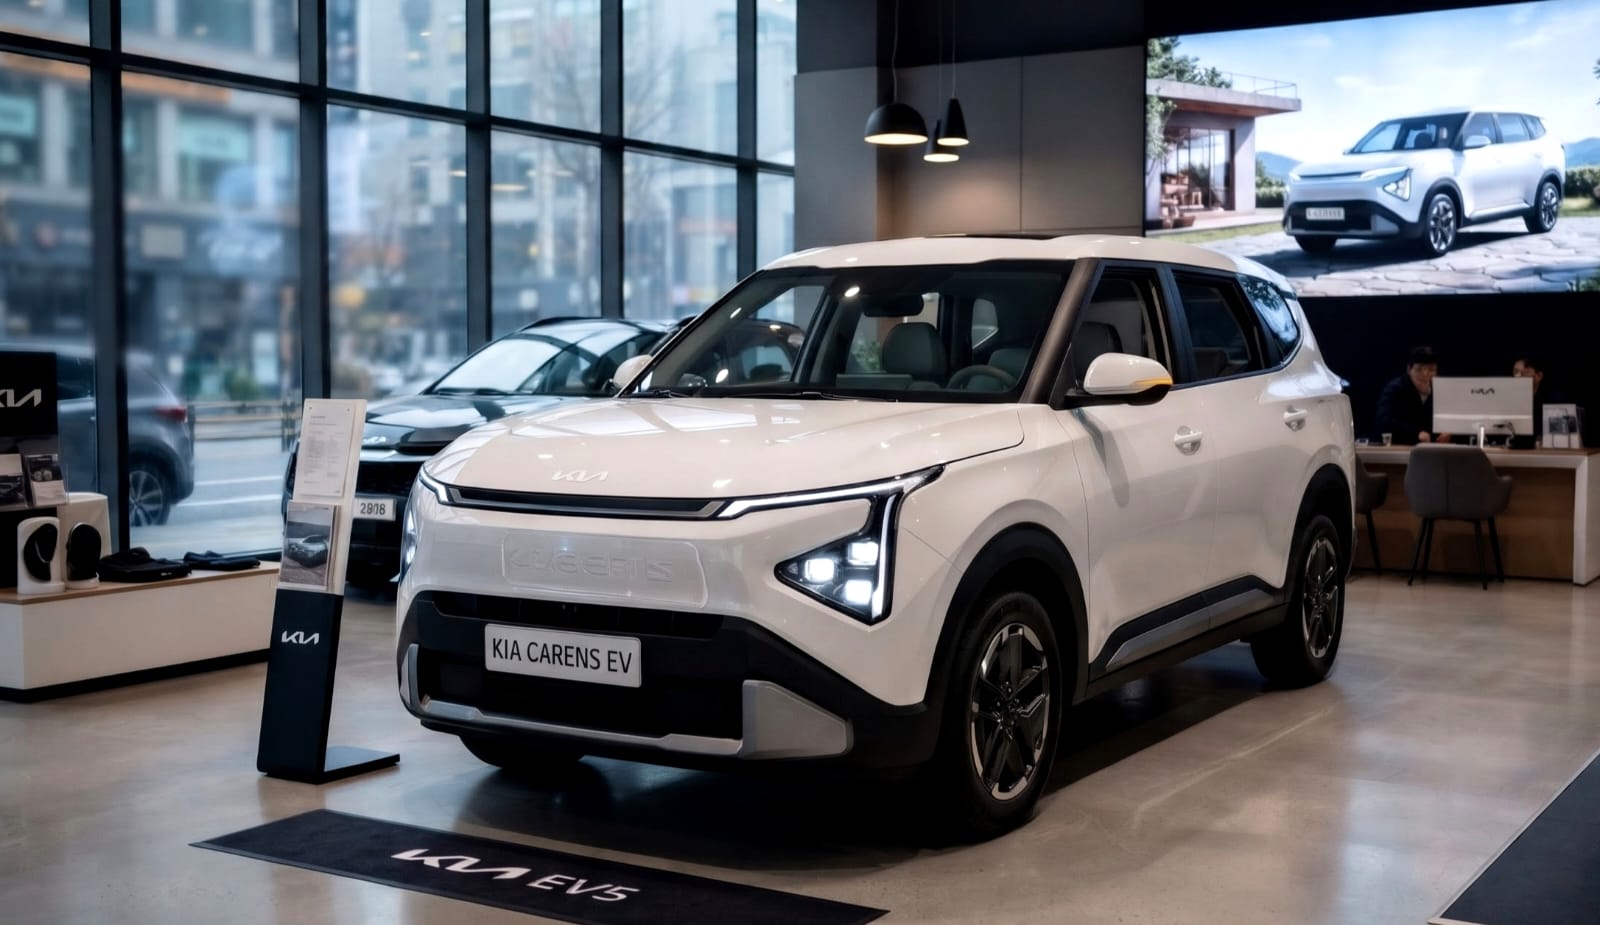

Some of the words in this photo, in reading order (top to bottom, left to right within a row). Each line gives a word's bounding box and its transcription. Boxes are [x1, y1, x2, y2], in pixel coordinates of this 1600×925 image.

[0, 388, 42, 408] IA
[551, 469, 608, 482] KIA
[281, 630, 320, 645] KIA
[492, 637, 522, 662] KIA
[526, 641, 601, 670] CARENS
[607, 650, 633, 674] EV
[391, 848, 532, 880] KIA
[525, 873, 641, 901] EV5
